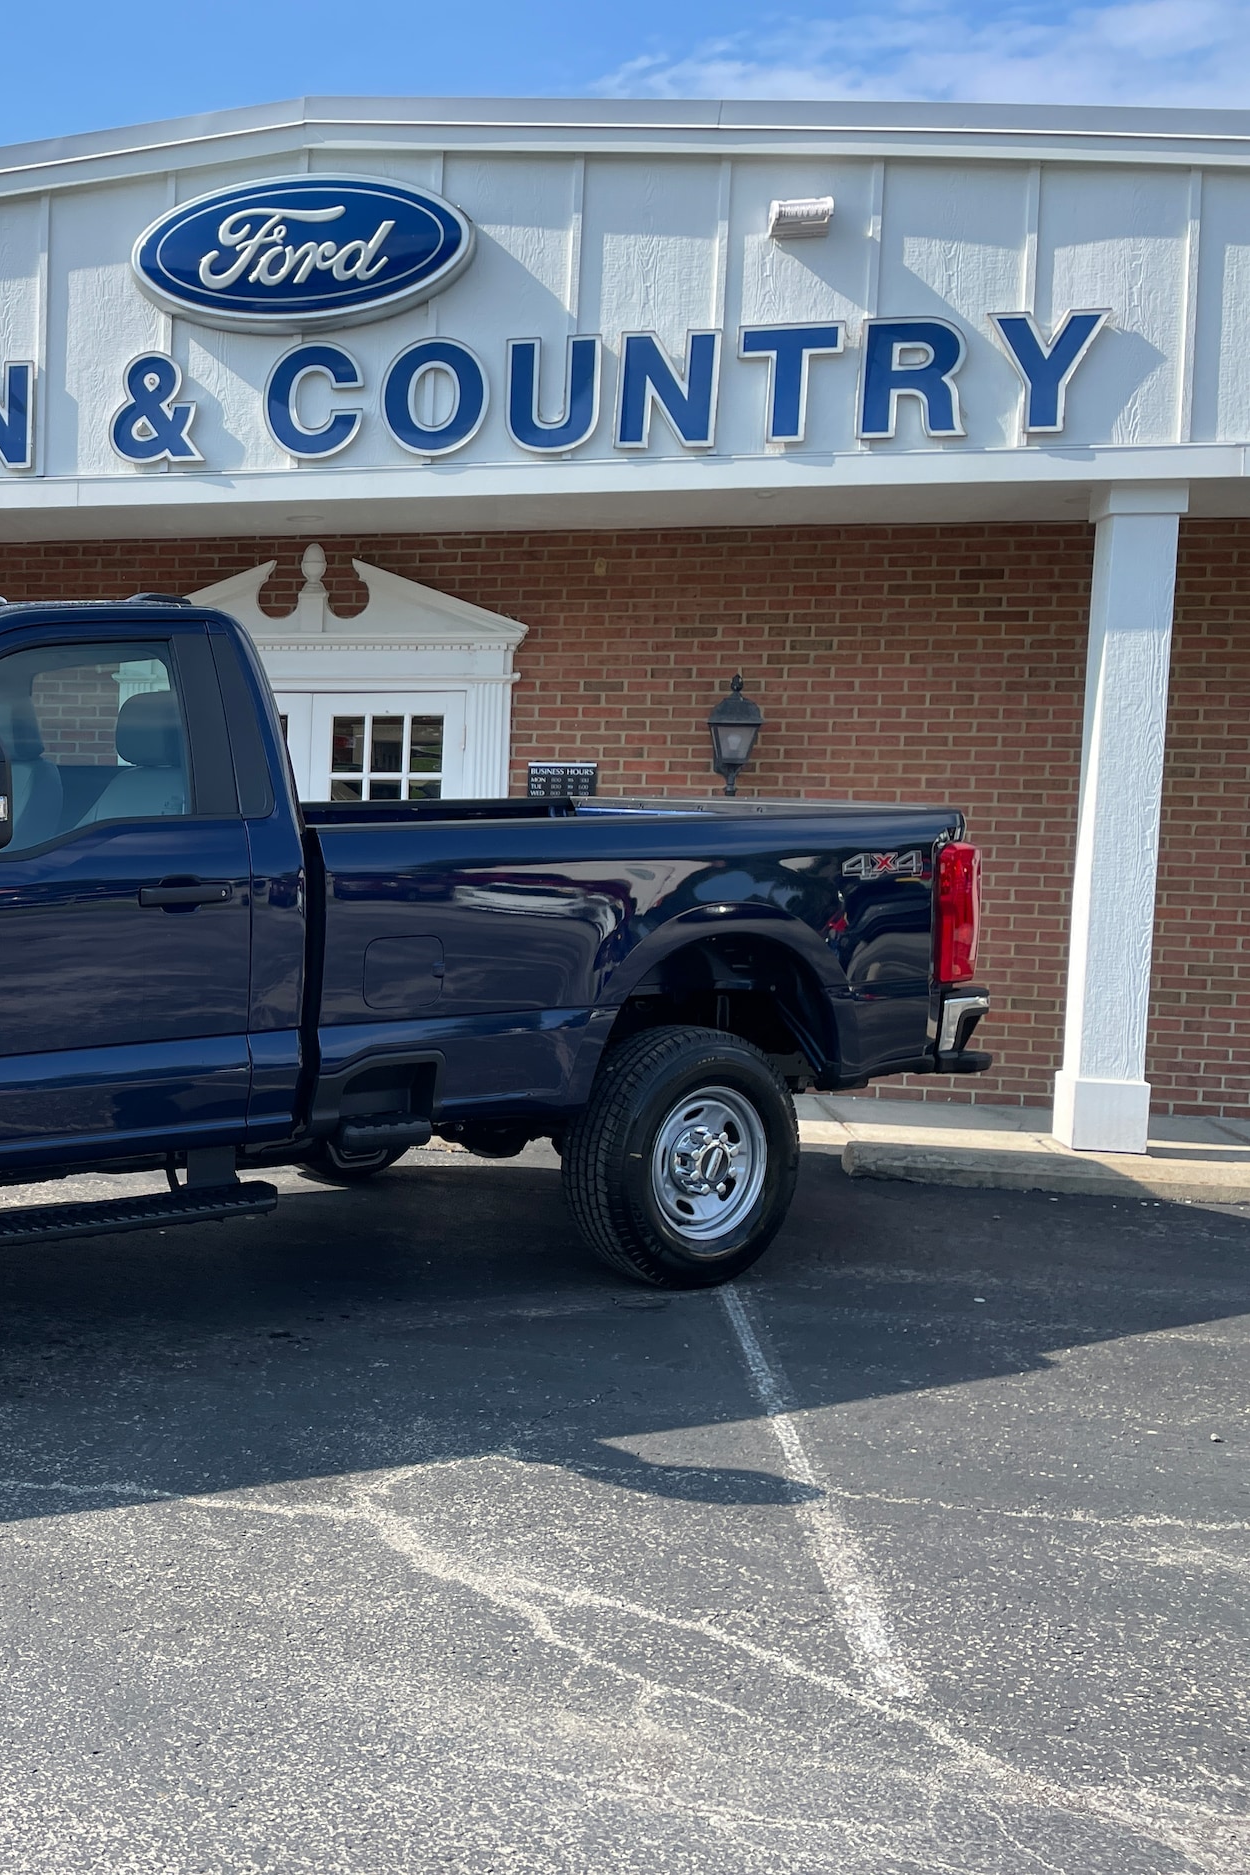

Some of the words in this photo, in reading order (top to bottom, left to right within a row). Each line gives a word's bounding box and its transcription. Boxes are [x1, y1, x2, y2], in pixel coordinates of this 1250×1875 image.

[199, 205, 396, 290] Ford
[109, 351, 205, 463] &
[265, 308, 1112, 459] COUNTRY
